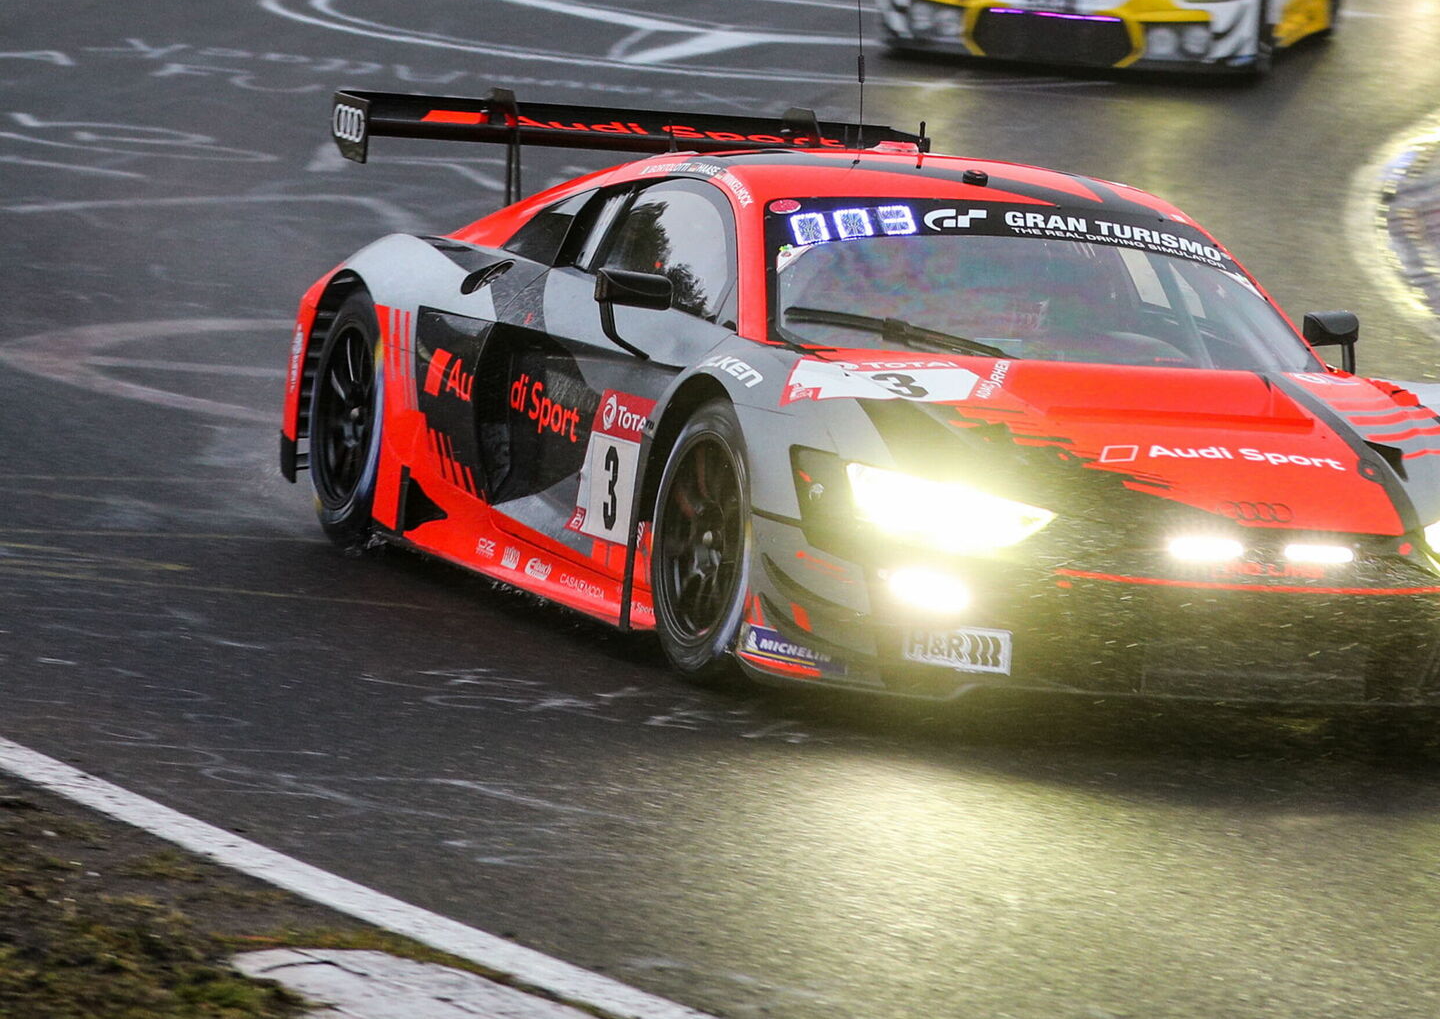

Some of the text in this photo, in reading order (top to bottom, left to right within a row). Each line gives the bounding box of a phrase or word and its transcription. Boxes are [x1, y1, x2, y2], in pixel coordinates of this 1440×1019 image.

[1004, 210, 1087, 233] GRAN
[1011, 227, 1227, 270] THE REAL DRIVING SIMULATOR
[870, 372, 930, 400] 3
[527, 381, 581, 444] Sport
[618, 405, 646, 432] TOTA
[1148, 444, 1347, 472] Audi Sport
[602, 445, 619, 531] 3
[759, 638, 832, 663] MICHELIN
